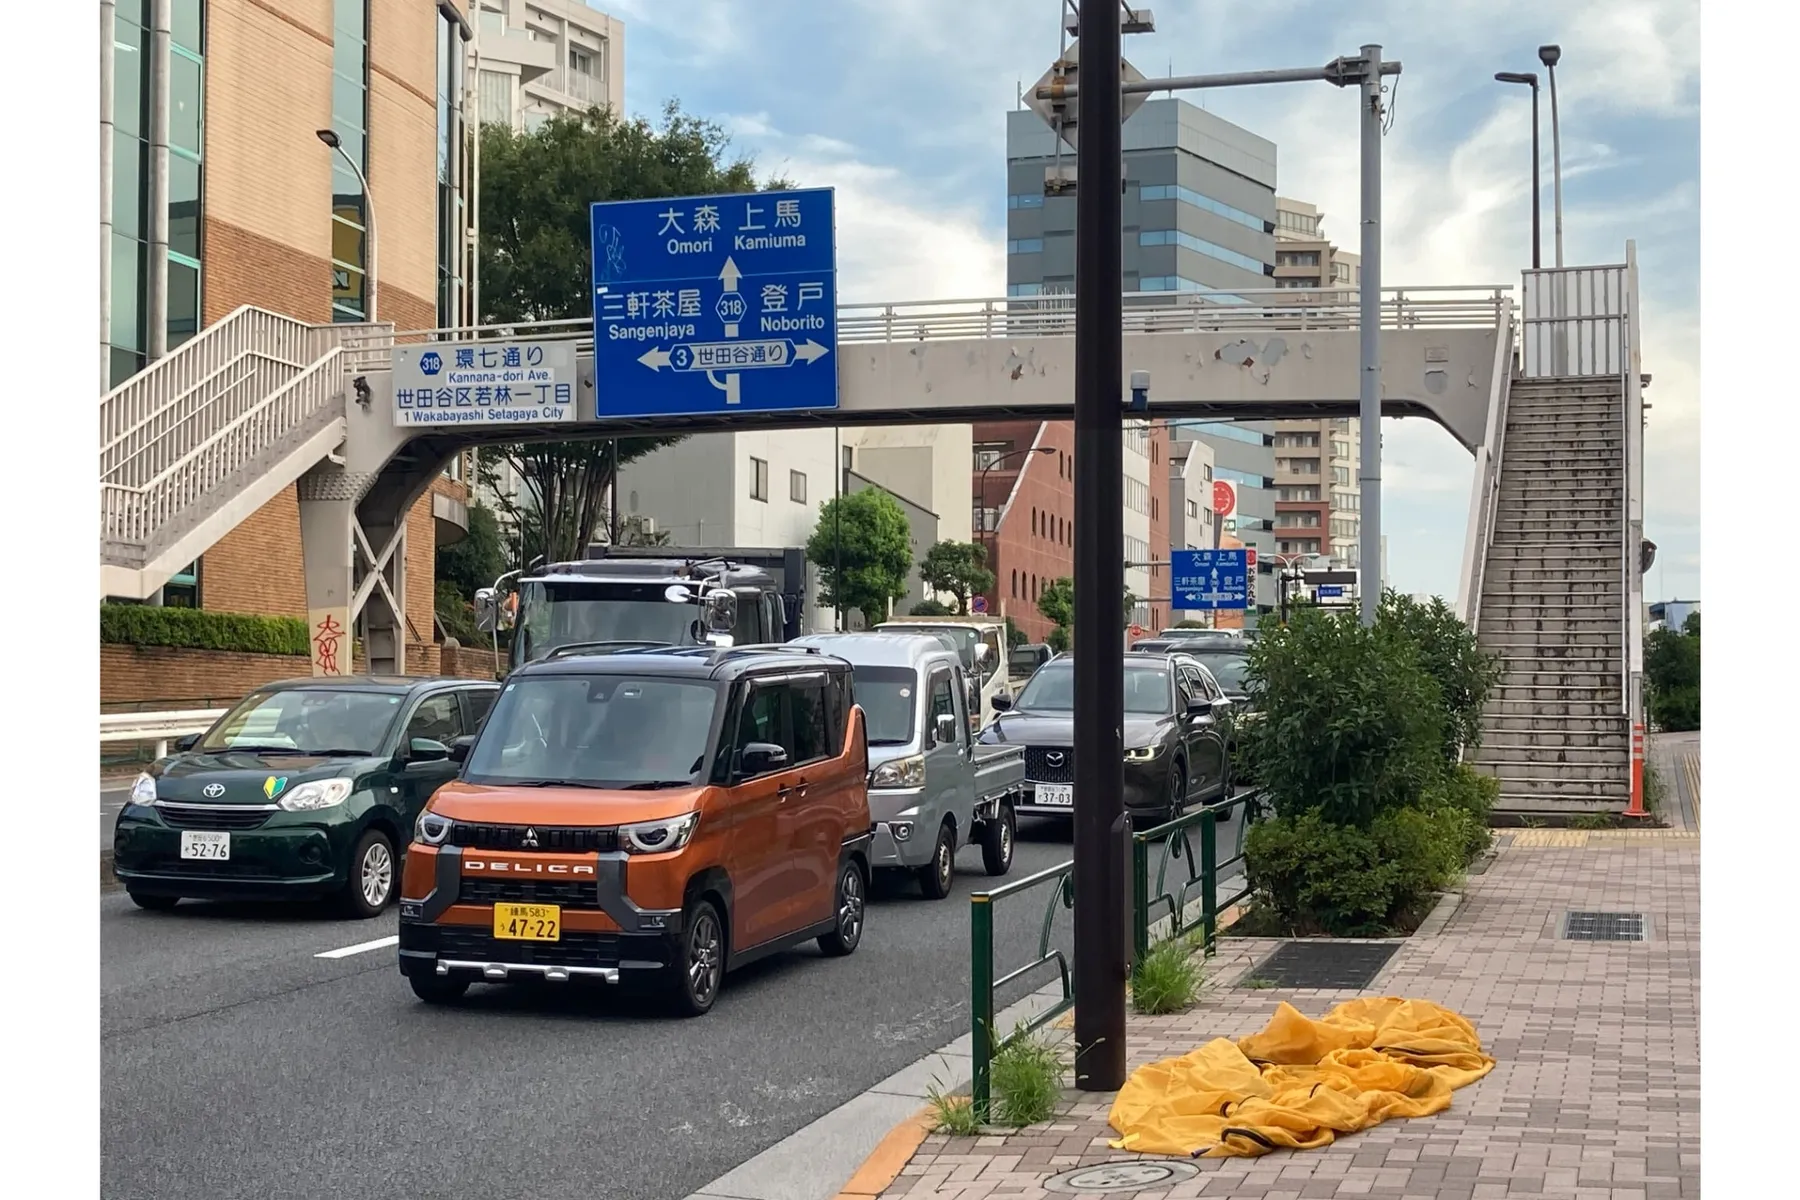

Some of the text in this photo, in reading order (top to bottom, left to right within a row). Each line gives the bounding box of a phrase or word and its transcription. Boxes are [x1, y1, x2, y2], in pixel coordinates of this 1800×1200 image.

[658, 199, 802, 236] 大森 上馬
[667, 233, 806, 254] Omori Kamiuma
[602, 288, 702, 320] 三軒茶屋
[760, 281, 824, 313] 登戸
[720, 299, 742, 316] 318
[608, 323, 696, 340] Sangenjaya
[760, 314, 825, 332] Noborito
[421, 357, 440, 371] 318
[455, 345, 543, 369] 環七通り
[676, 350, 687, 366] 3
[698, 344, 783, 366] 世田谷通り
[448, 369, 552, 384] Kannana-dori Ave.
[397, 383, 571, 409] 世田谷区若林一丁目
[404, 406, 564, 423] 1 Wakabayashi Setagaya City
[191, 842, 227, 858] 52-76
[464, 860, 594, 875] DELICA
[509, 918, 556, 938] 47-22
